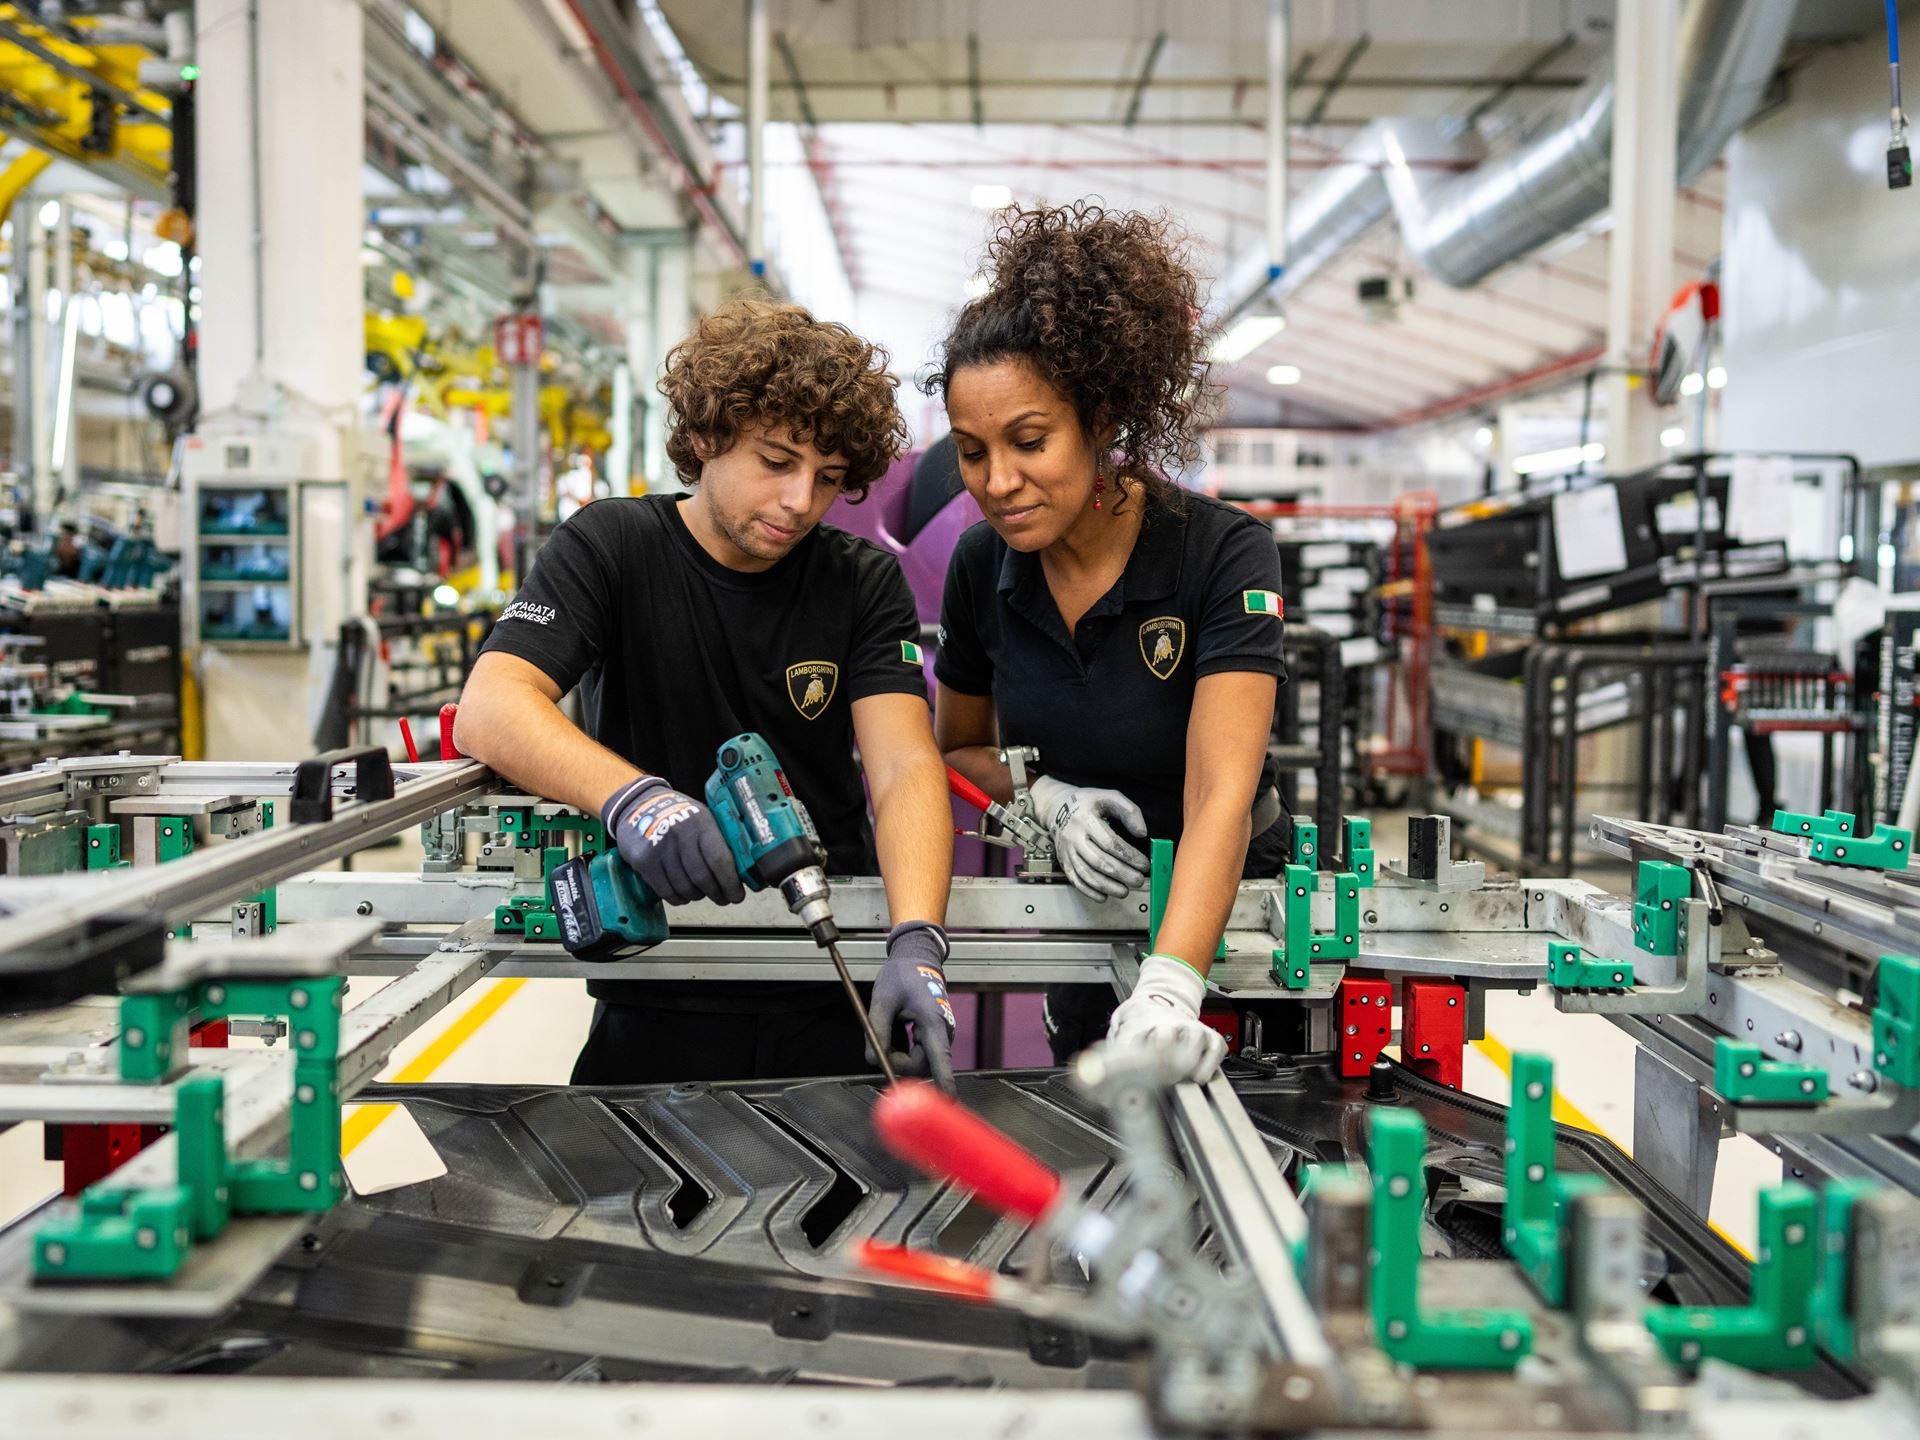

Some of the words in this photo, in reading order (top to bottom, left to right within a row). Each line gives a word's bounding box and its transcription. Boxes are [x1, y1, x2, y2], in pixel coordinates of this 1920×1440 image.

[496, 610, 551, 625] OGNESE
[1142, 620, 1181, 635] LAMBORGHINI
[790, 665, 834, 678] LAMBORGHINI
[647, 805, 700, 847] uvex
